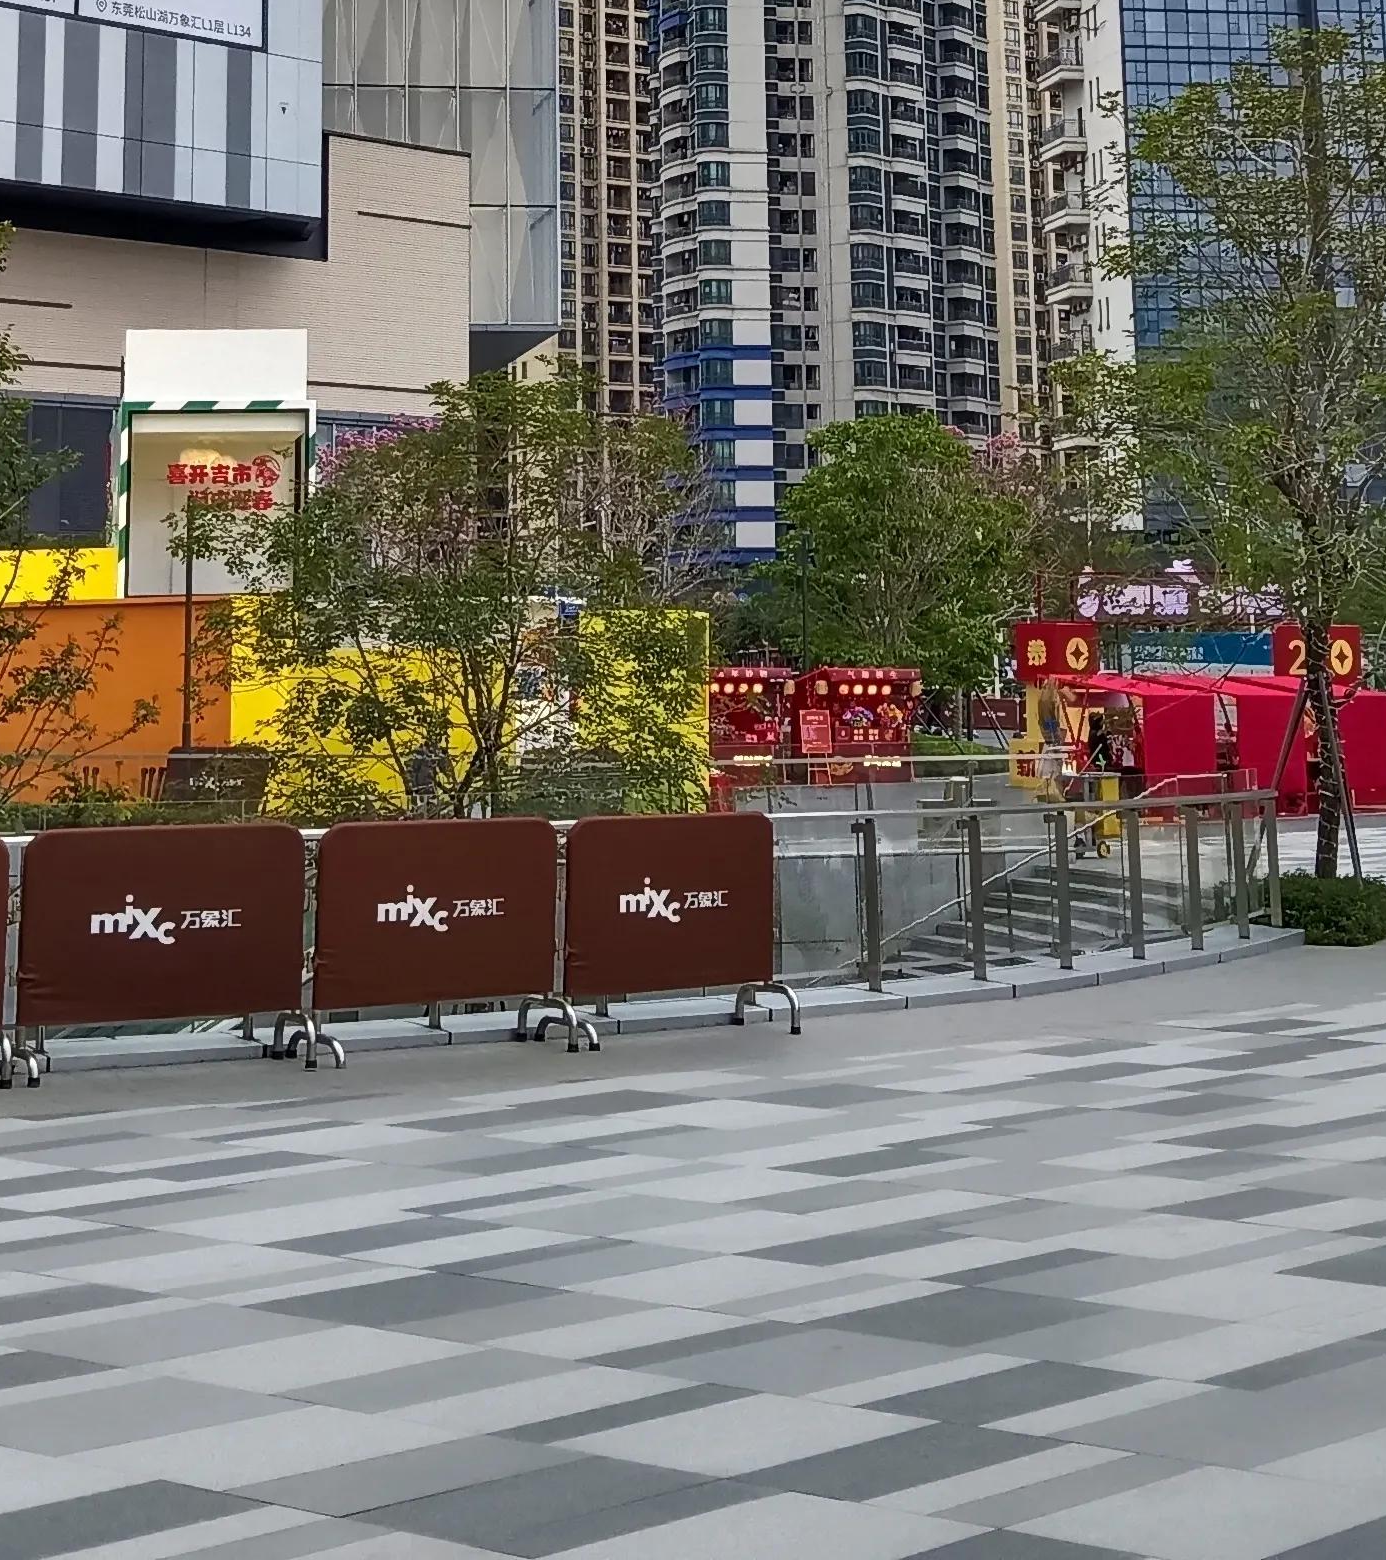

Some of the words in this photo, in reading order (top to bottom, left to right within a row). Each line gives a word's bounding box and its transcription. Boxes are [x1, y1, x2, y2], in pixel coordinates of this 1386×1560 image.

[227, 23, 252, 38] L134
[452, 897, 505, 918] 万象汇
[683, 890, 729, 909] 万象汇
[180, 908, 243, 930] 万象汇
